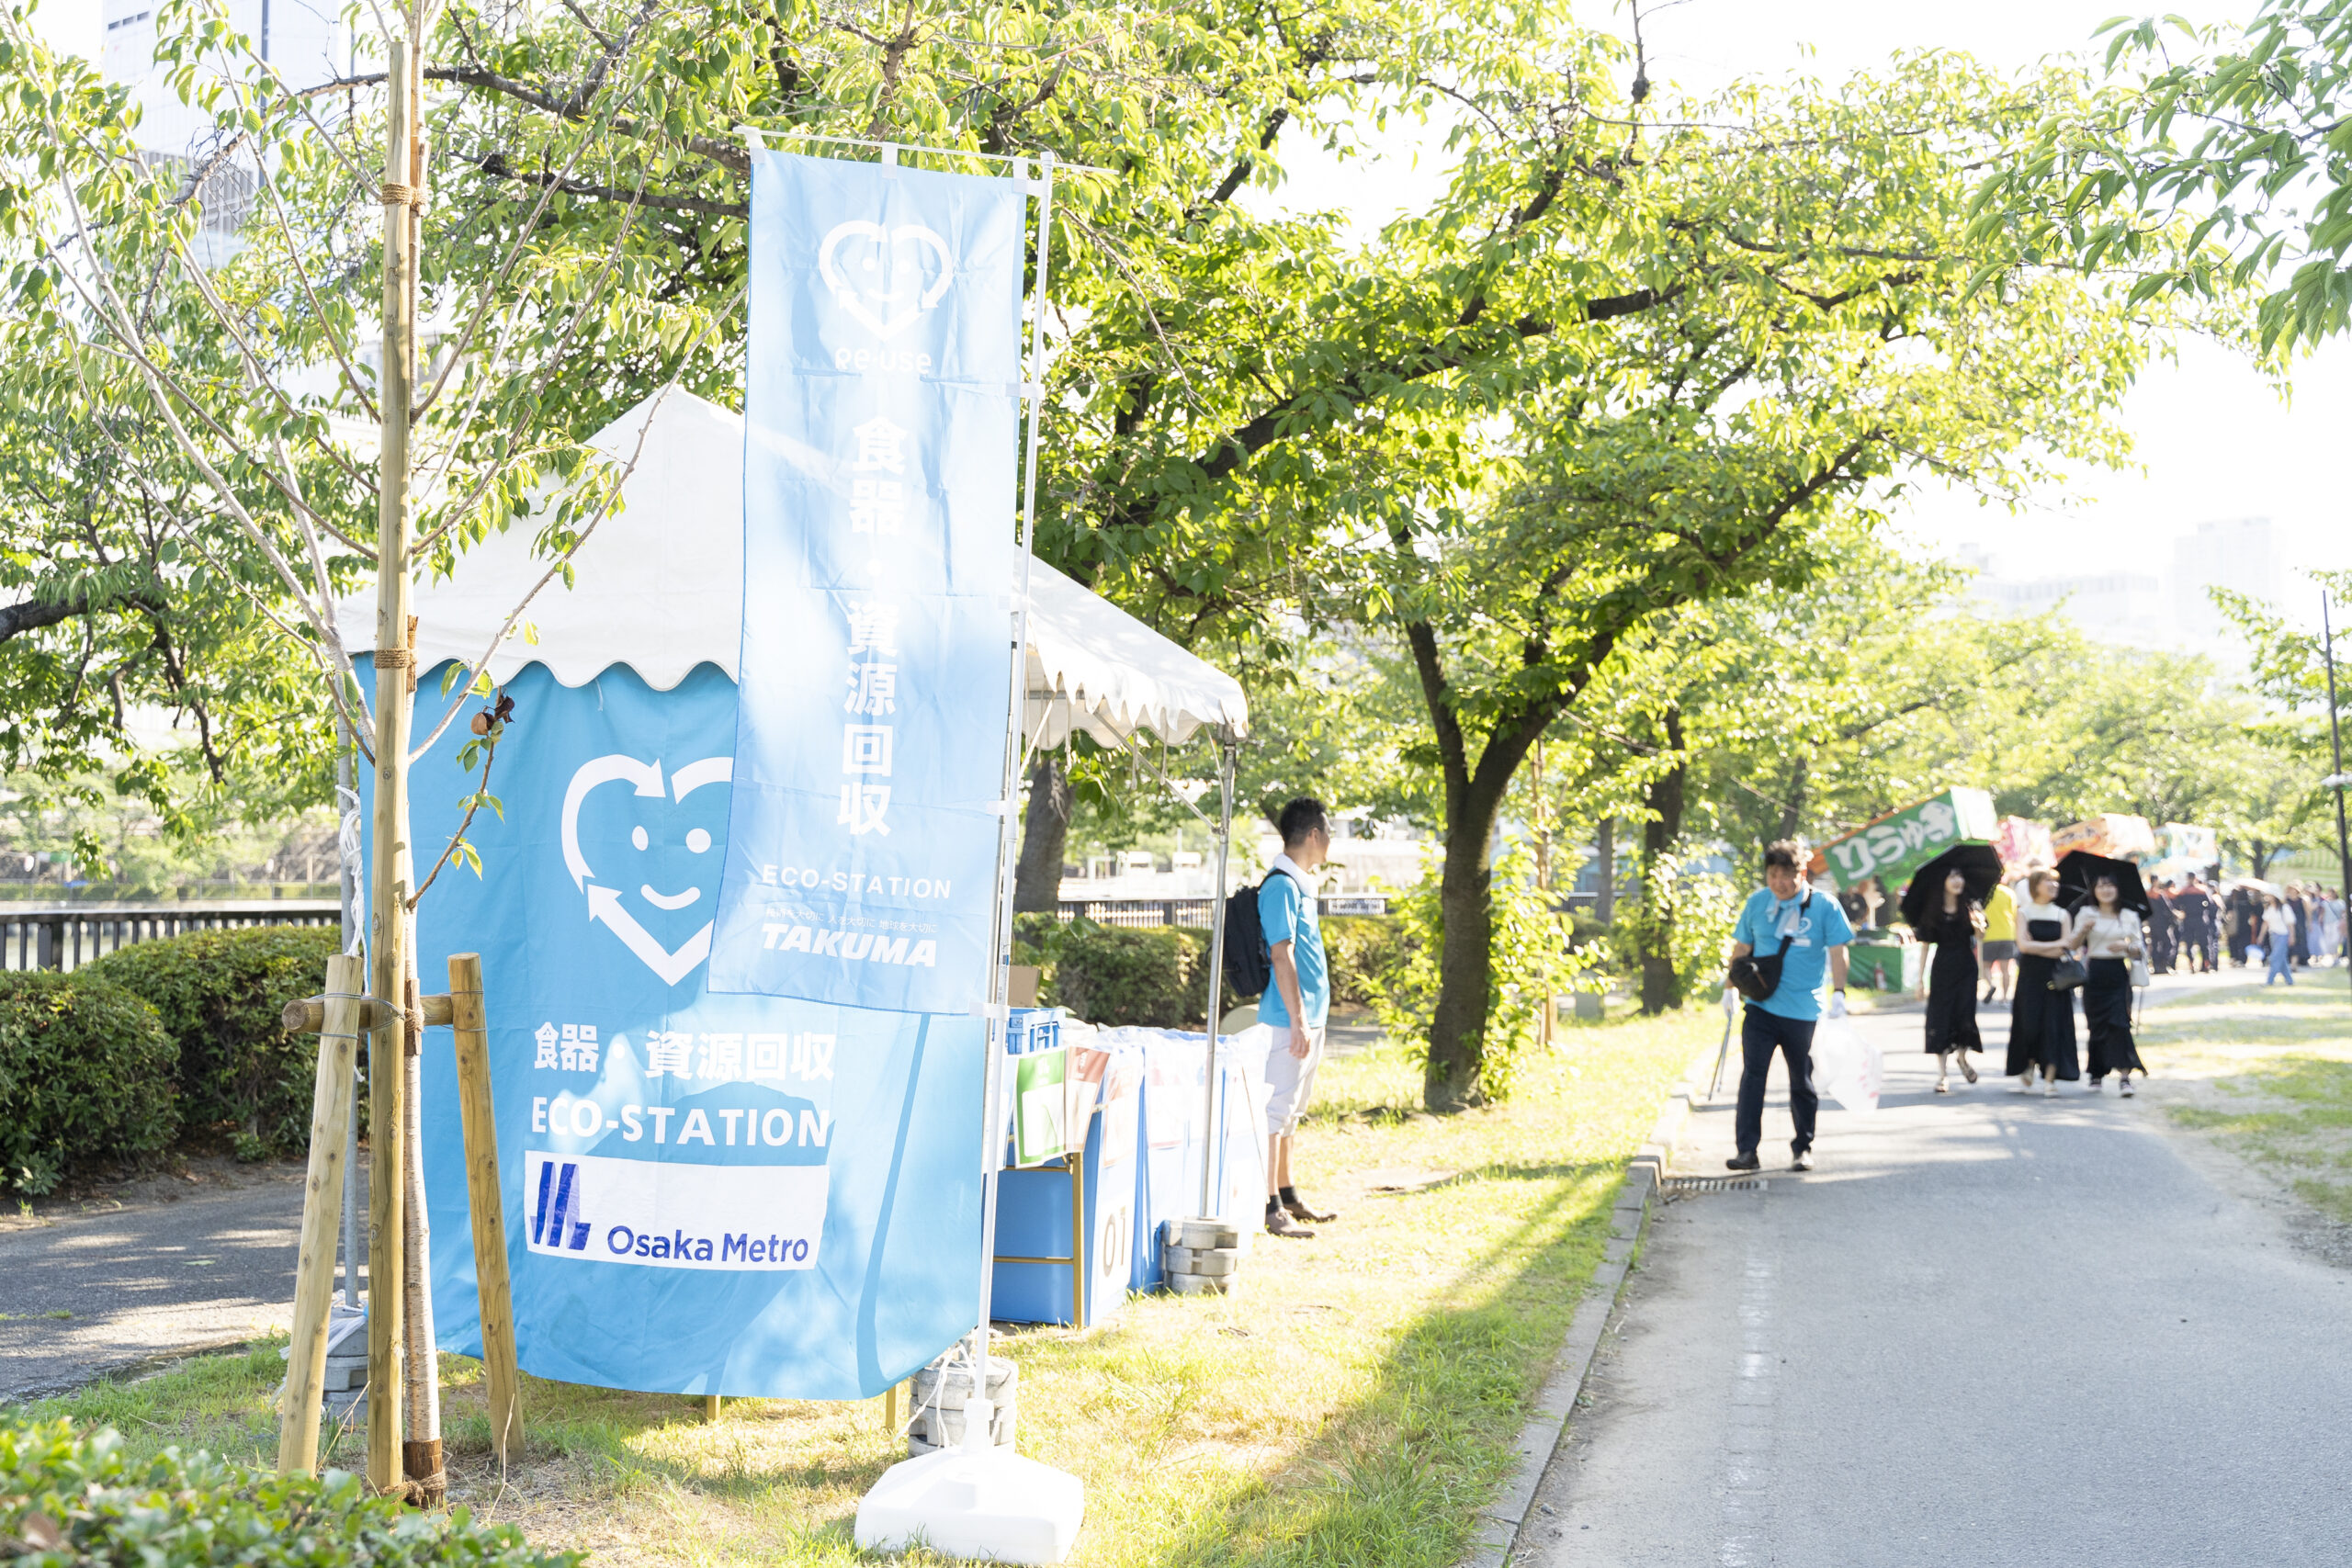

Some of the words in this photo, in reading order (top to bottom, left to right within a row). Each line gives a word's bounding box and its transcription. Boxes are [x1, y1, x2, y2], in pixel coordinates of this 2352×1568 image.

[762, 863, 952, 899] ECO-STATION
[762, 922, 937, 967] TAKUMA
[531, 1096, 830, 1147] ECO-STATION
[607, 1225, 714, 1262] Osaka
[721, 1233, 809, 1263] Metro
